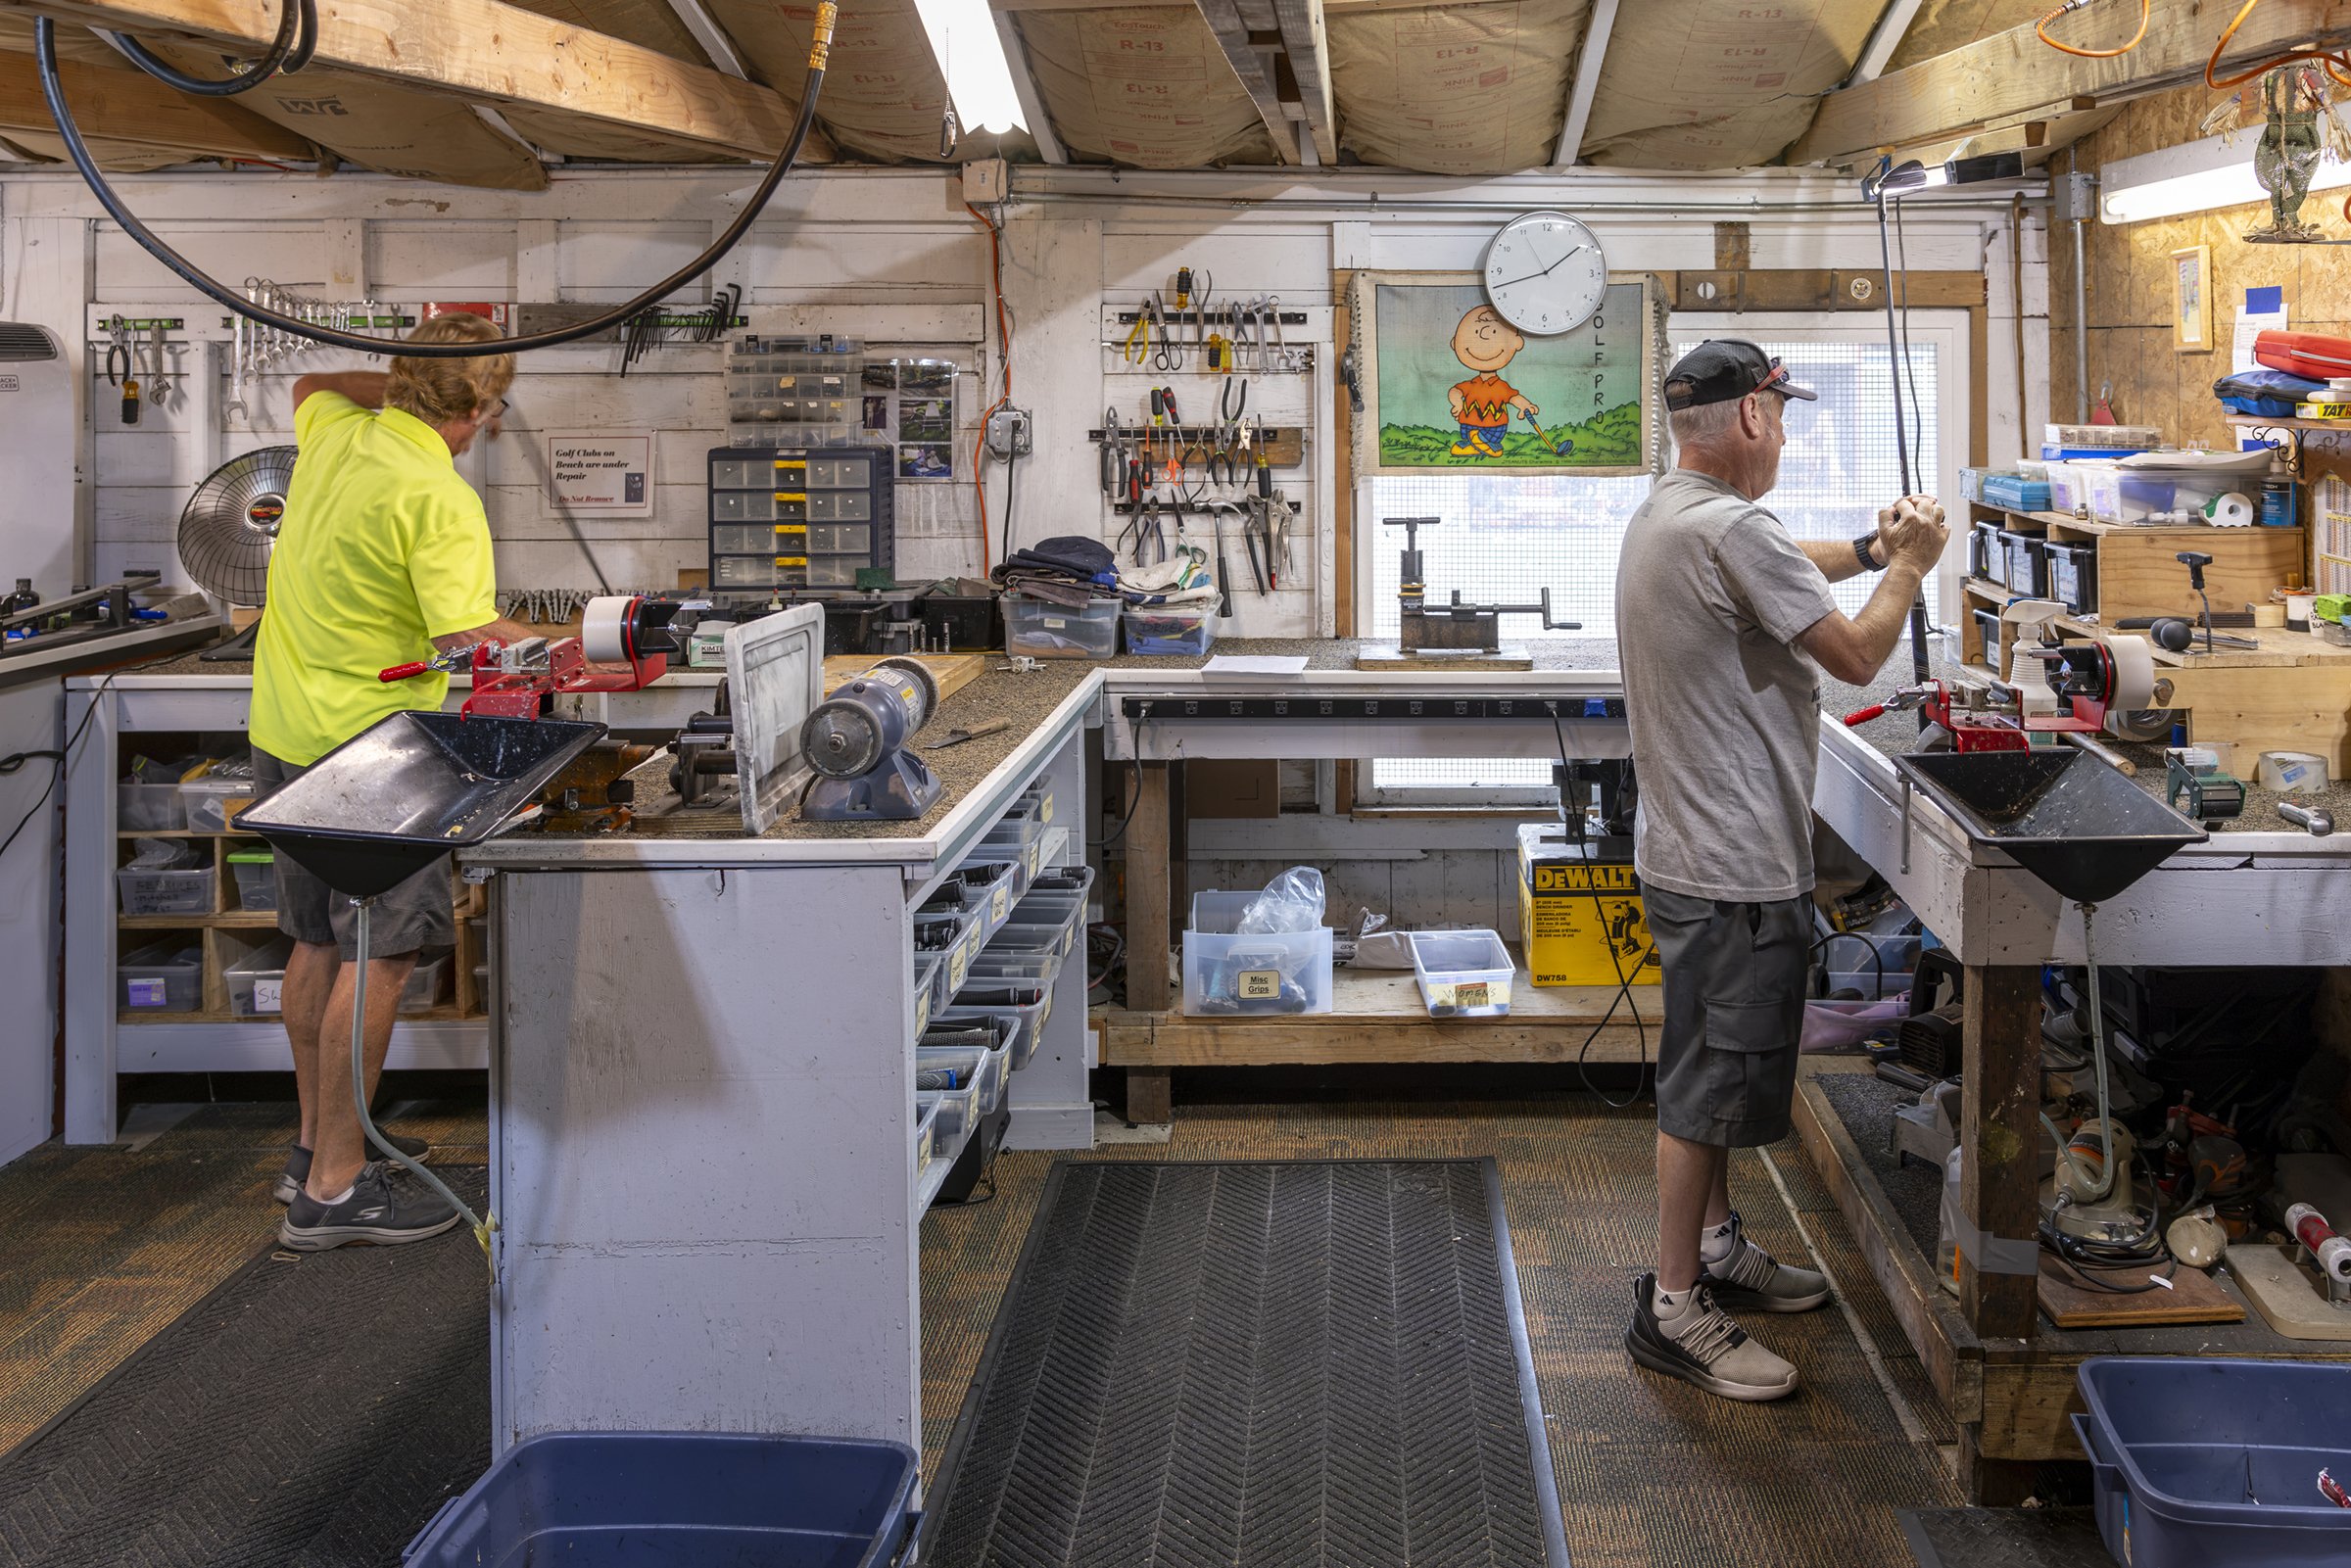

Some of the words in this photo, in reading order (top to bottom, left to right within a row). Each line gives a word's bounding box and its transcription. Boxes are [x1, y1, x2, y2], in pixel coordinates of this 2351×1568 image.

[1739, 9, 1783, 19] R-13
[836, 39, 878, 48] R-13
[1120, 40, 1165, 52] R-13
[1436, 46, 1479, 59] R-13
[1126, 83, 1168, 94] R-13
[1542, 223, 1552, 232] 12
[1497, 266, 1503, 275] 9
[1589, 269, 1595, 278] 3
[1541, 313, 1548, 322] 6
[1594, 373, 1605, 425] PRO
[555, 450, 576, 459] Golf
[555, 460, 584, 469] Bench
[555, 472, 587, 483] Repair
